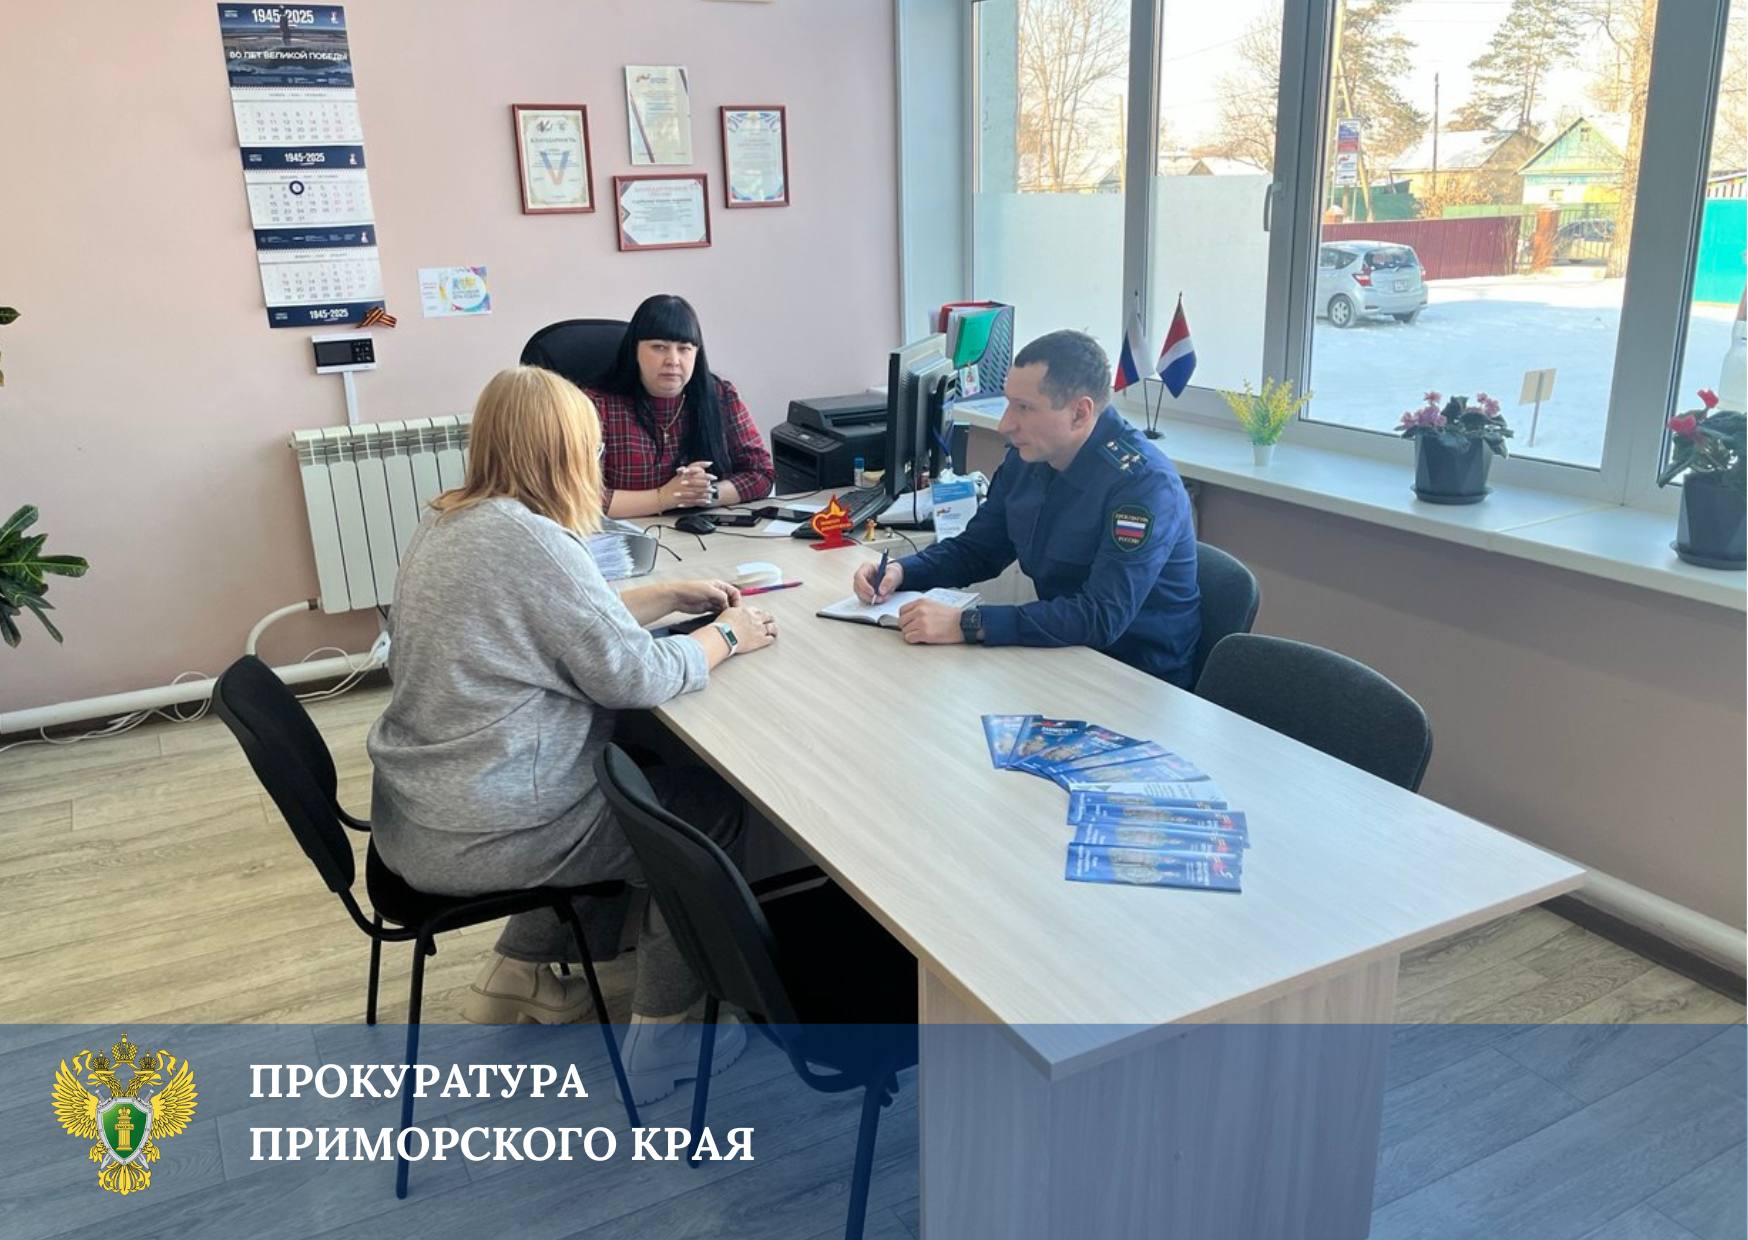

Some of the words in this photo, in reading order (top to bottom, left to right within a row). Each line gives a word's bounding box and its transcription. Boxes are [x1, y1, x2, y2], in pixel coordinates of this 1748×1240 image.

[243, 51, 262, 60] ЛЕТ
[263, 50, 308, 60] ВЕЛИКОЙ
[309, 51, 348, 61] ПОБЕДЫ
[284, 152, 325, 163] 1945-2025
[309, 308, 349, 320] 1945-2025
